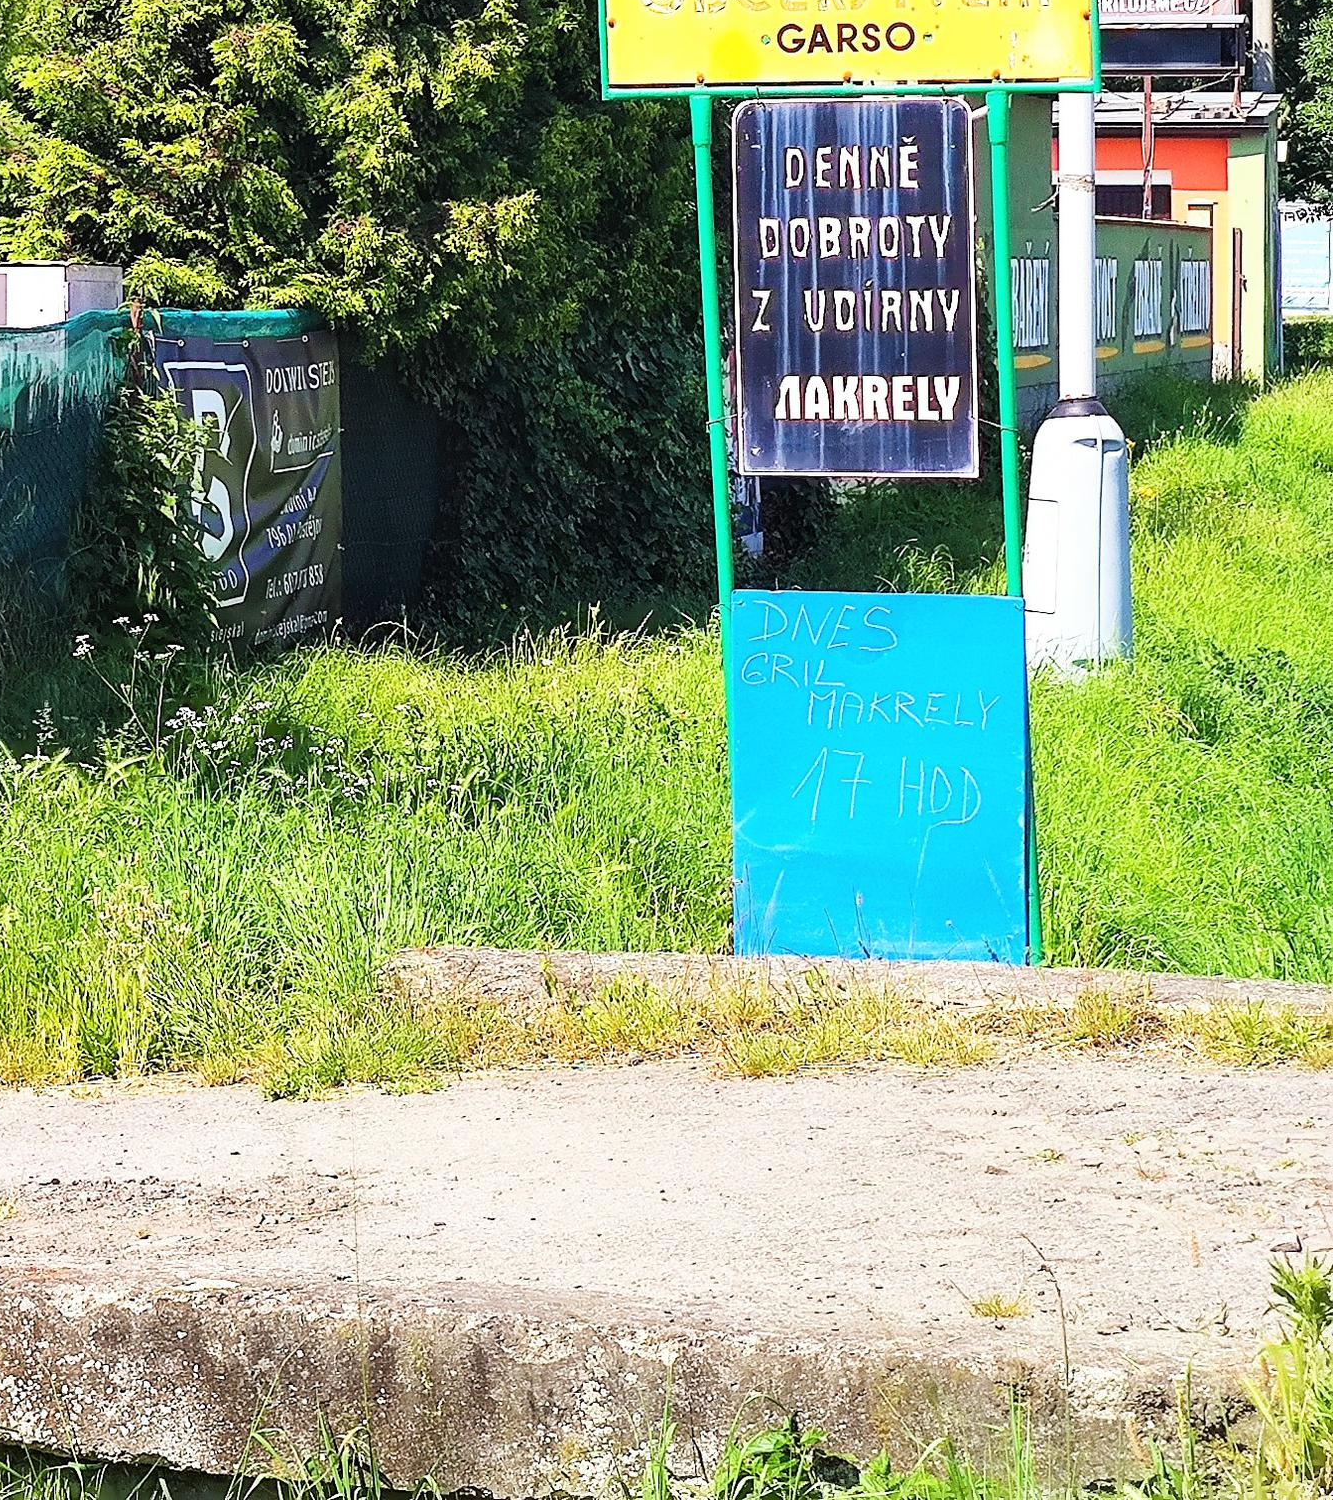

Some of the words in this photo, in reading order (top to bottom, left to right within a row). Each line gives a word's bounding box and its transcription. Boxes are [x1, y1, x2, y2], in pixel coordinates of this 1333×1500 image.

[784, 137, 920, 189] DENNĚ
[759, 215, 953, 260] DOBROTY
[751, 288, 773, 333] Z
[804, 278, 961, 333] UDÍRNY
[748, 599, 899, 652] DNES
[741, 651, 846, 689] GRIL
[807, 689, 1001, 731] MAKRELY
[790, 745, 874, 822] 17
